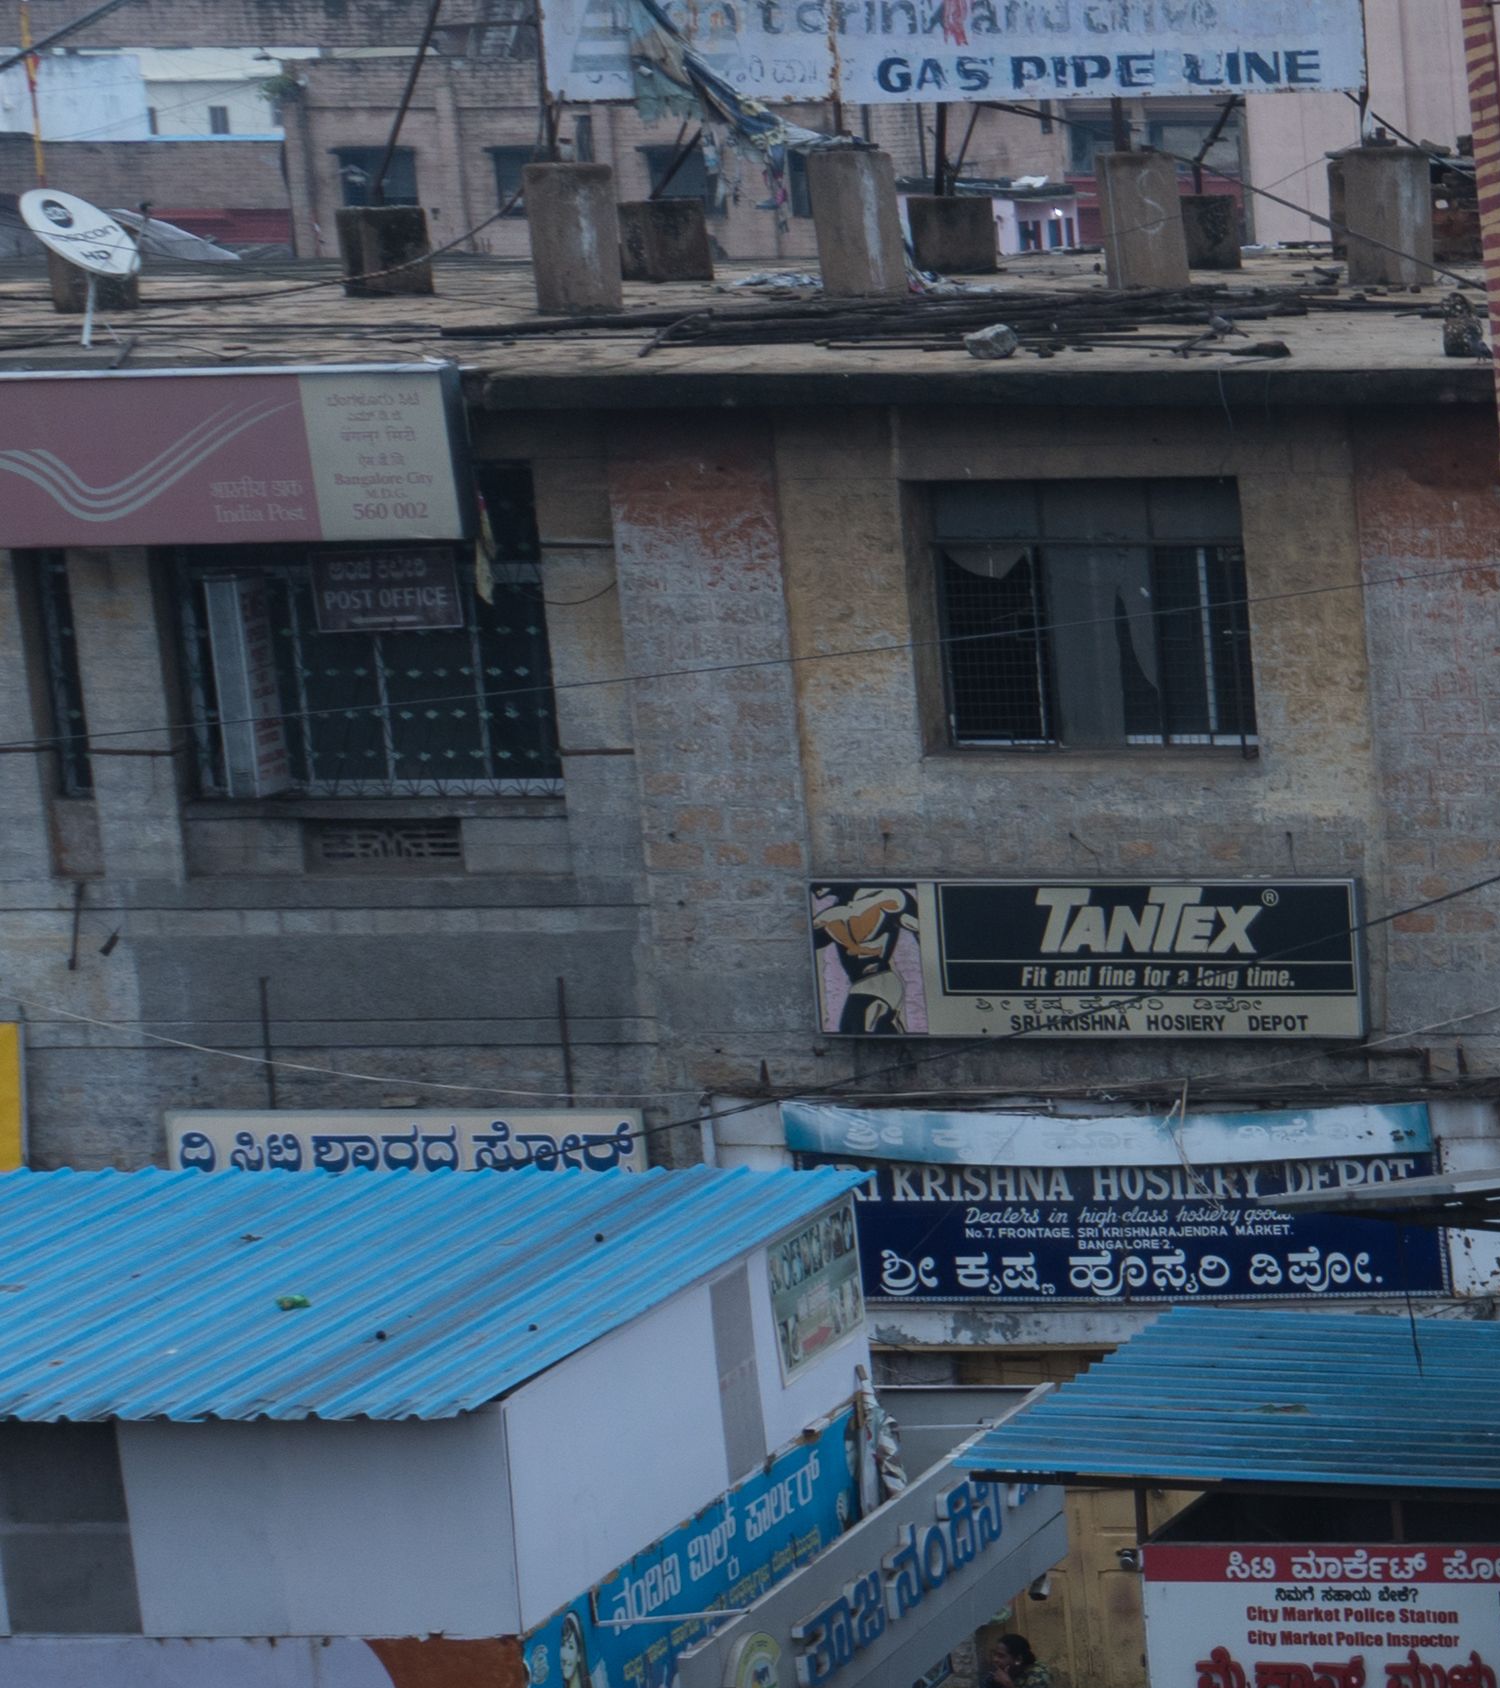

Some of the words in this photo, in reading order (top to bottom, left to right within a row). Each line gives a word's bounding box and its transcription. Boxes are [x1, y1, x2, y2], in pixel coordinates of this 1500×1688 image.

[876, 54, 994, 94] GAS
[1010, 50, 1155, 90] PIPE
[1184, 48, 1322, 86] LINE
[80, 250, 112, 262] HD
[333, 472, 403, 488] Bangalore
[405, 471, 434, 486] City
[215, 503, 263, 523] India
[267, 502, 308, 521] Post
[353, 503, 388, 520] 560
[392, 502, 428, 519] 002
[323, 589, 374, 610] POST
[378, 586, 450, 608] OFFICE
[1022, 966, 1047, 988] Fit
[1053, 966, 1090, 988] and
[1098, 966, 1135, 988] fine
[1142, 966, 1171, 988] for
[1177, 970, 1188, 987] a
[1196, 967, 1239, 990] long
[1246, 966, 1296, 989] time.
[1010, 1014, 1040, 1032] SRI
[1046, 1014, 1131, 1032] KRISHNA
[1147, 1014, 1226, 1032] HOSIERY
[1248, 1014, 1309, 1032] DEPOT
[892, 1165, 1074, 1201] KRISHNA
[1093, 1163, 1260, 1201] HOSIERY
[965, 1206, 1040, 1225] Dealers
[1048, 1206, 1070, 1225] in
[1175, 1202, 1242, 1227] hosiery
[1078, 1227, 1099, 1238] SRI
[1102, 1225, 1228, 1238] KRISHNARAJENDRA
[881, 1249, 939, 1296] ಶ್ರೀ
[955, 1251, 1056, 1296] ಕೃಷ್ಣ
[1226, 1552, 1276, 1580] ಸಿಟಿ
[1291, 1550, 1428, 1581] ಮಾರ್ಕೆಟ್
[1246, 1606, 1279, 1624] City
[1282, 1606, 1341, 1623] Market
[1344, 1607, 1397, 1623] Police
[1400, 1607, 1459, 1624] Station
[1247, 1630, 1277, 1648] City
[1279, 1630, 1333, 1647] Market
[1336, 1631, 1385, 1648] Police
[1387, 1632, 1460, 1651] Inspector
